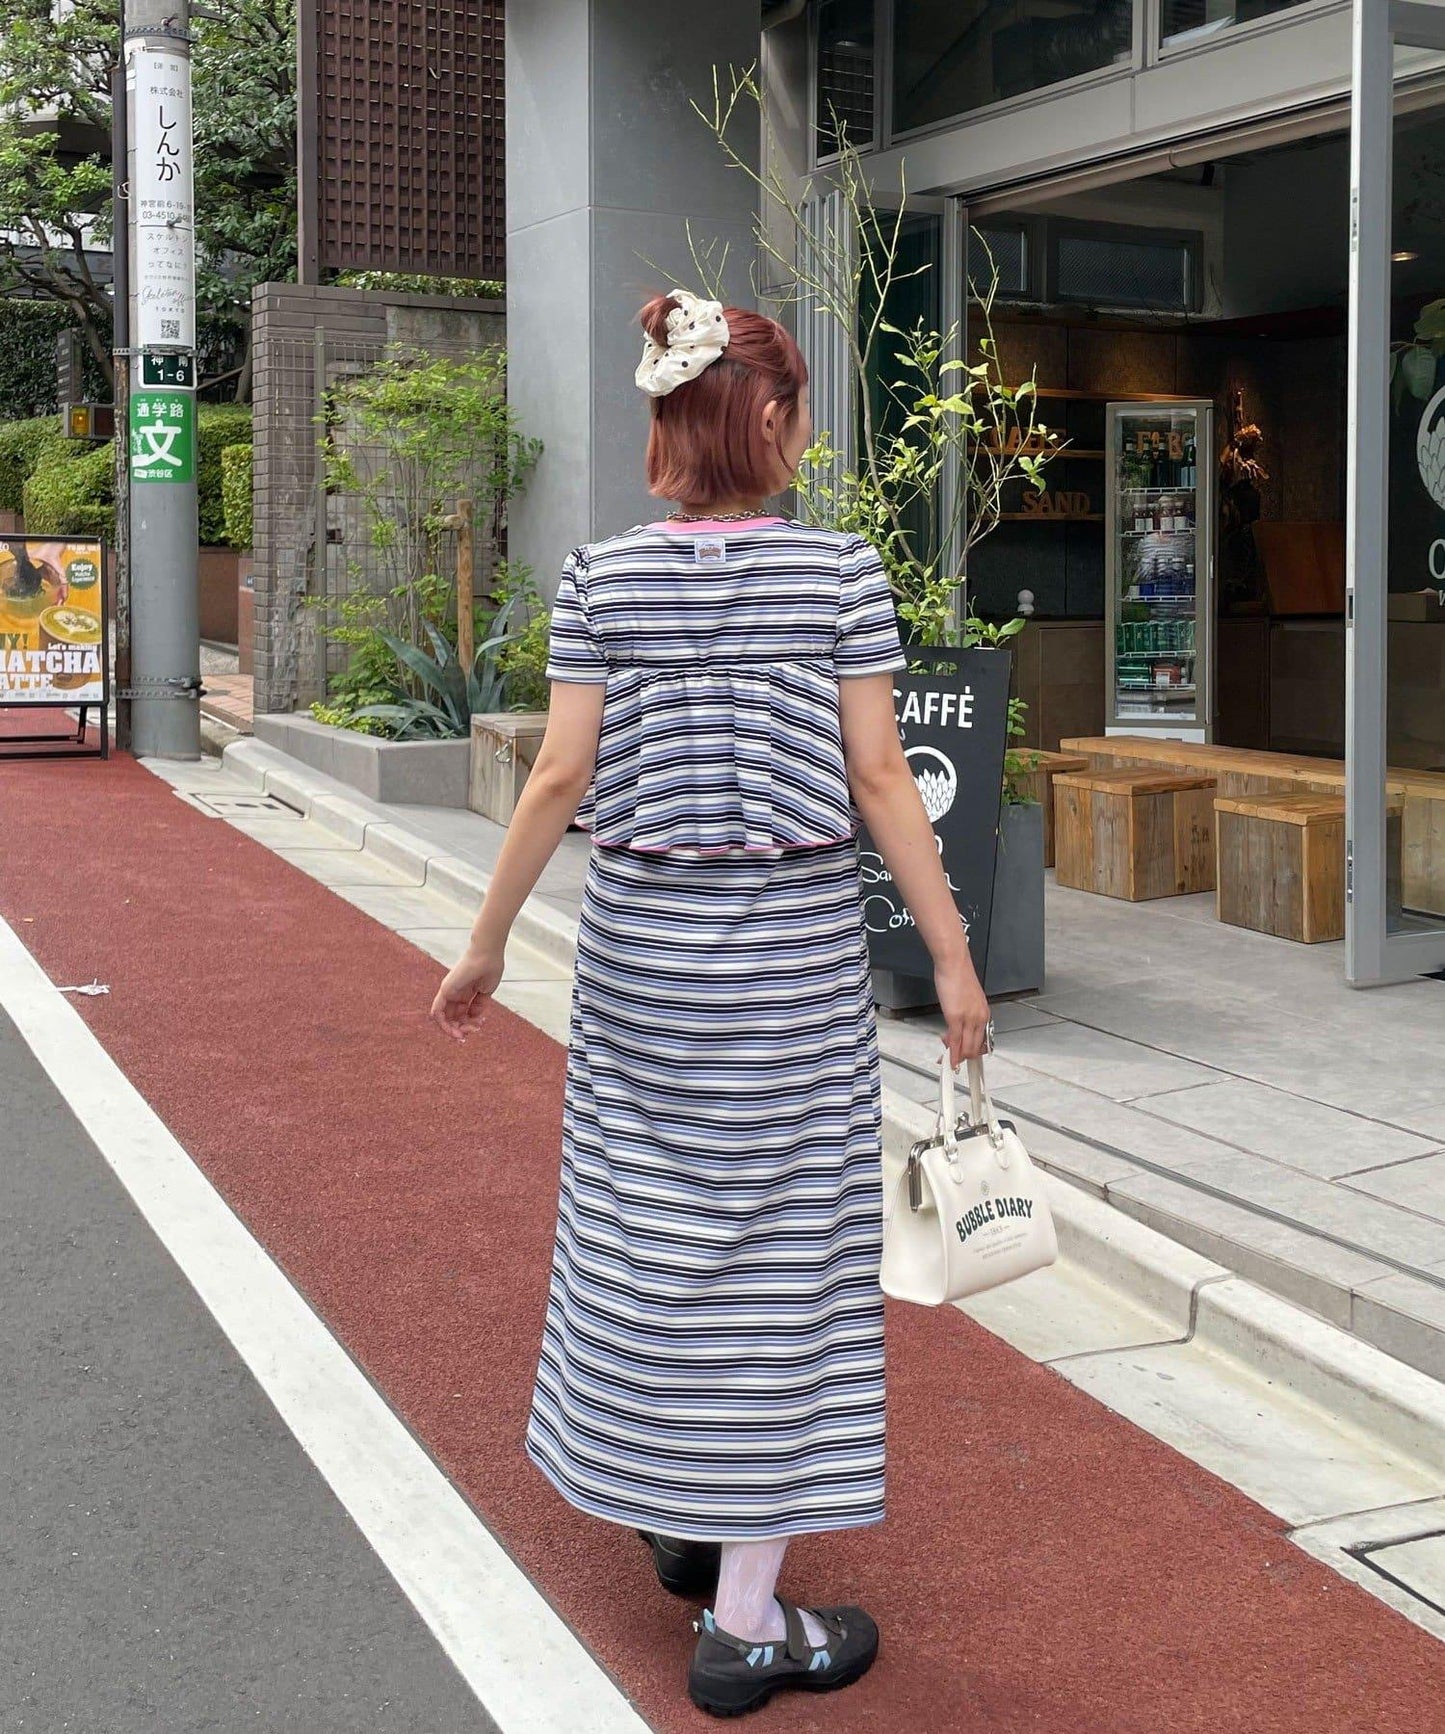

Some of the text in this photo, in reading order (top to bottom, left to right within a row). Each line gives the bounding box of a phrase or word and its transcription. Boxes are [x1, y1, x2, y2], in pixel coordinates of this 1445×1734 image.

[150, 87, 183, 98] 株式会社
[156, 105, 181, 181] しんか
[157, 369, 185, 382] 1-6
[137, 402, 184, 418] 通学路
[147, 469, 173, 479] 渋谷区
[1021, 490, 1091, 513] SAND
[71, 563, 93, 572] Enjoy
[955, 1197, 1033, 1242] BUBBLE DIARY
